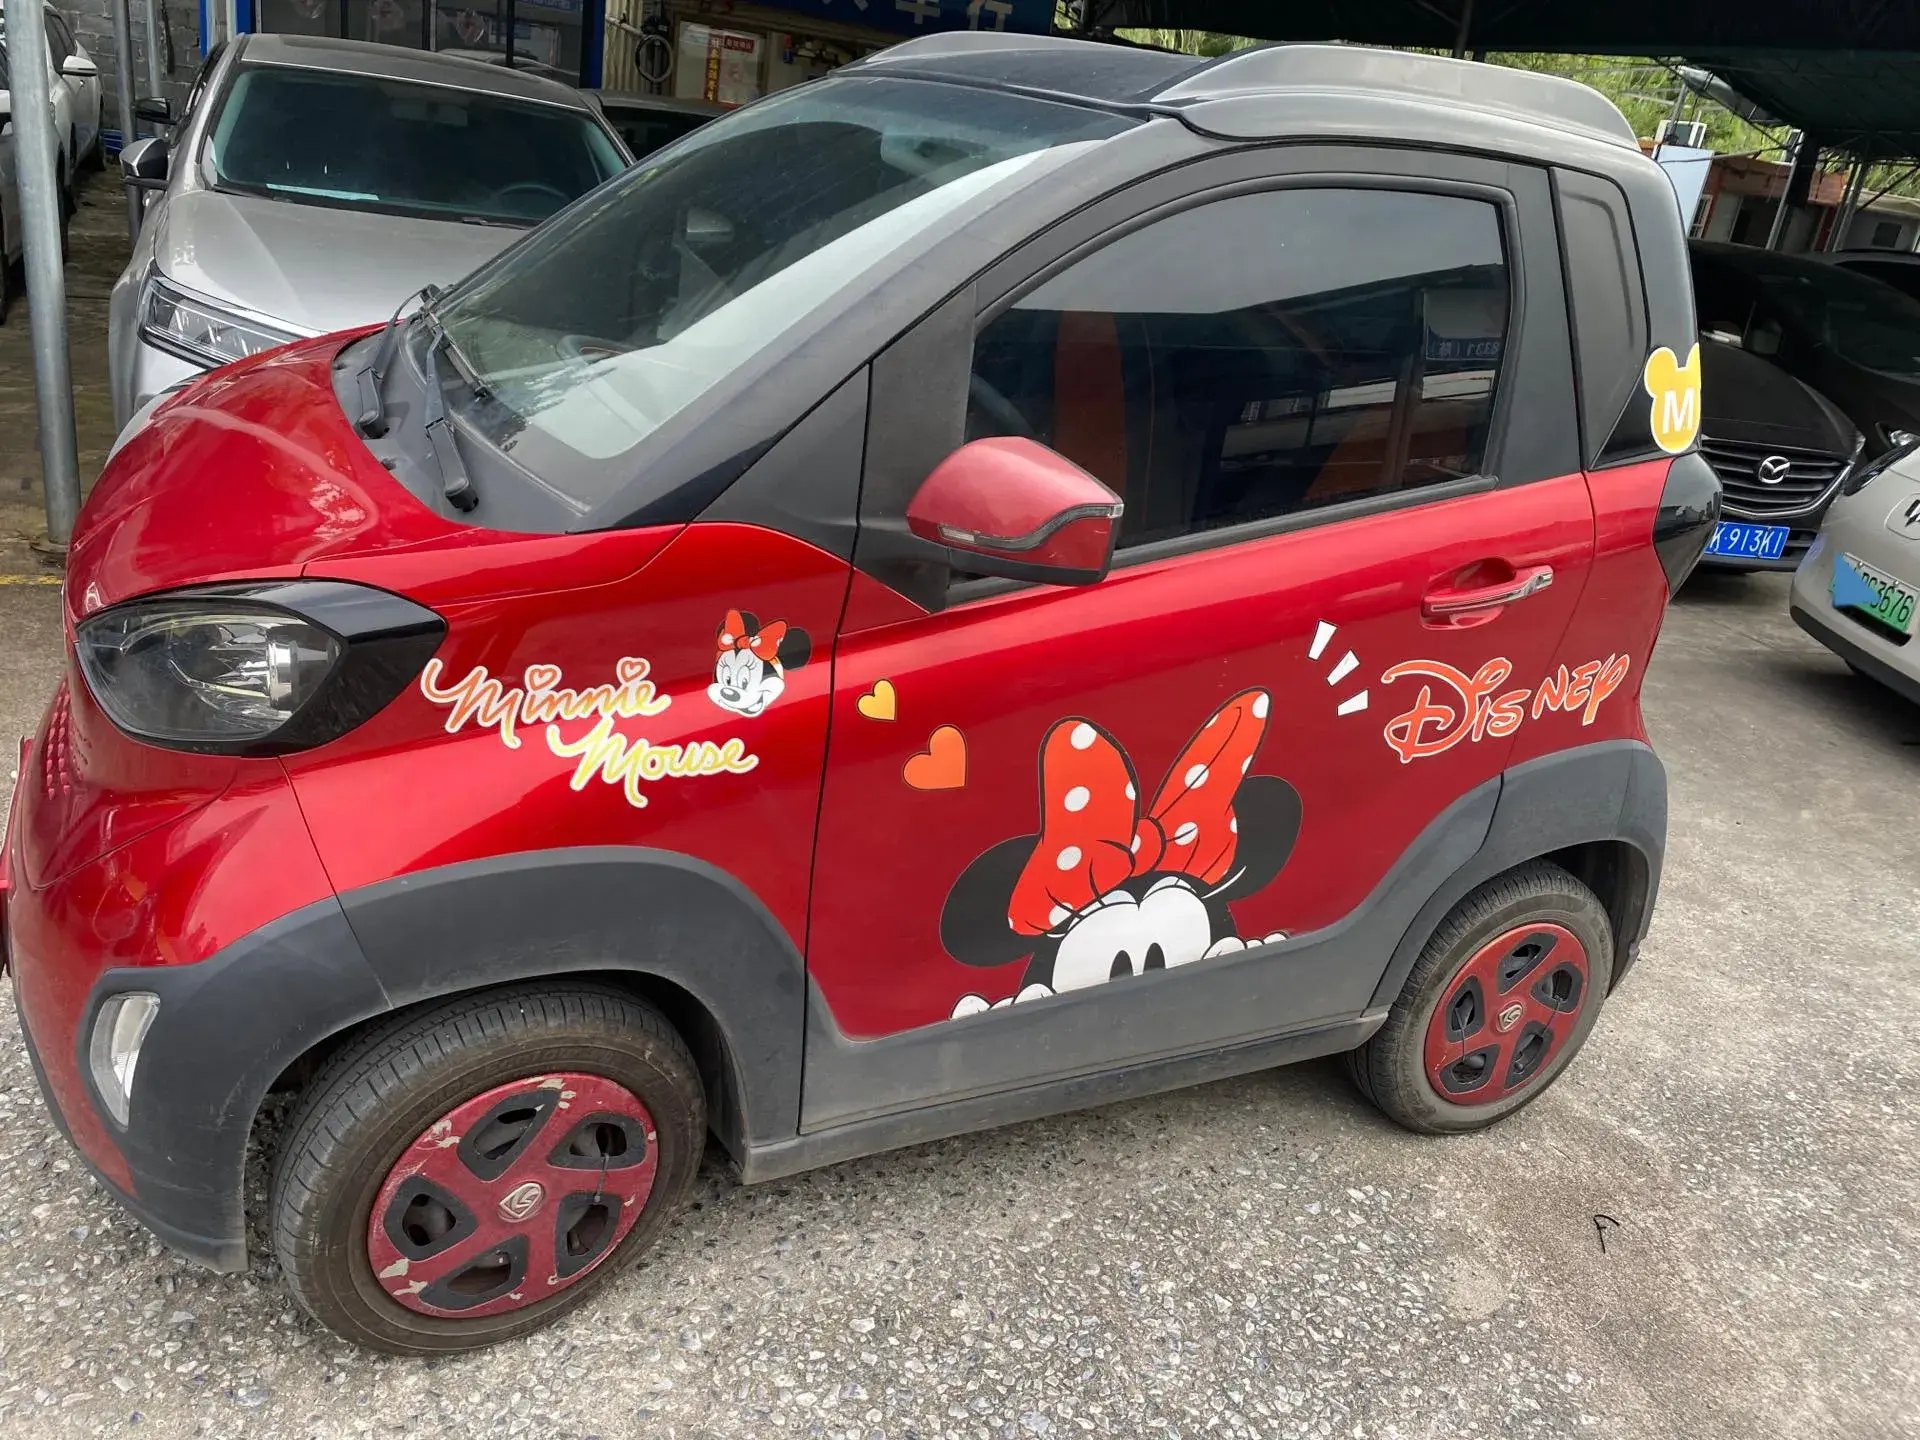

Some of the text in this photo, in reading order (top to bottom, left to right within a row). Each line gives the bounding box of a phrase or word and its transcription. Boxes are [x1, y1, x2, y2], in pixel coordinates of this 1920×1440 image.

[1661, 387, 1694, 434] M
[421, 657, 671, 748] Minnie
[546, 716, 759, 808] Mouse
